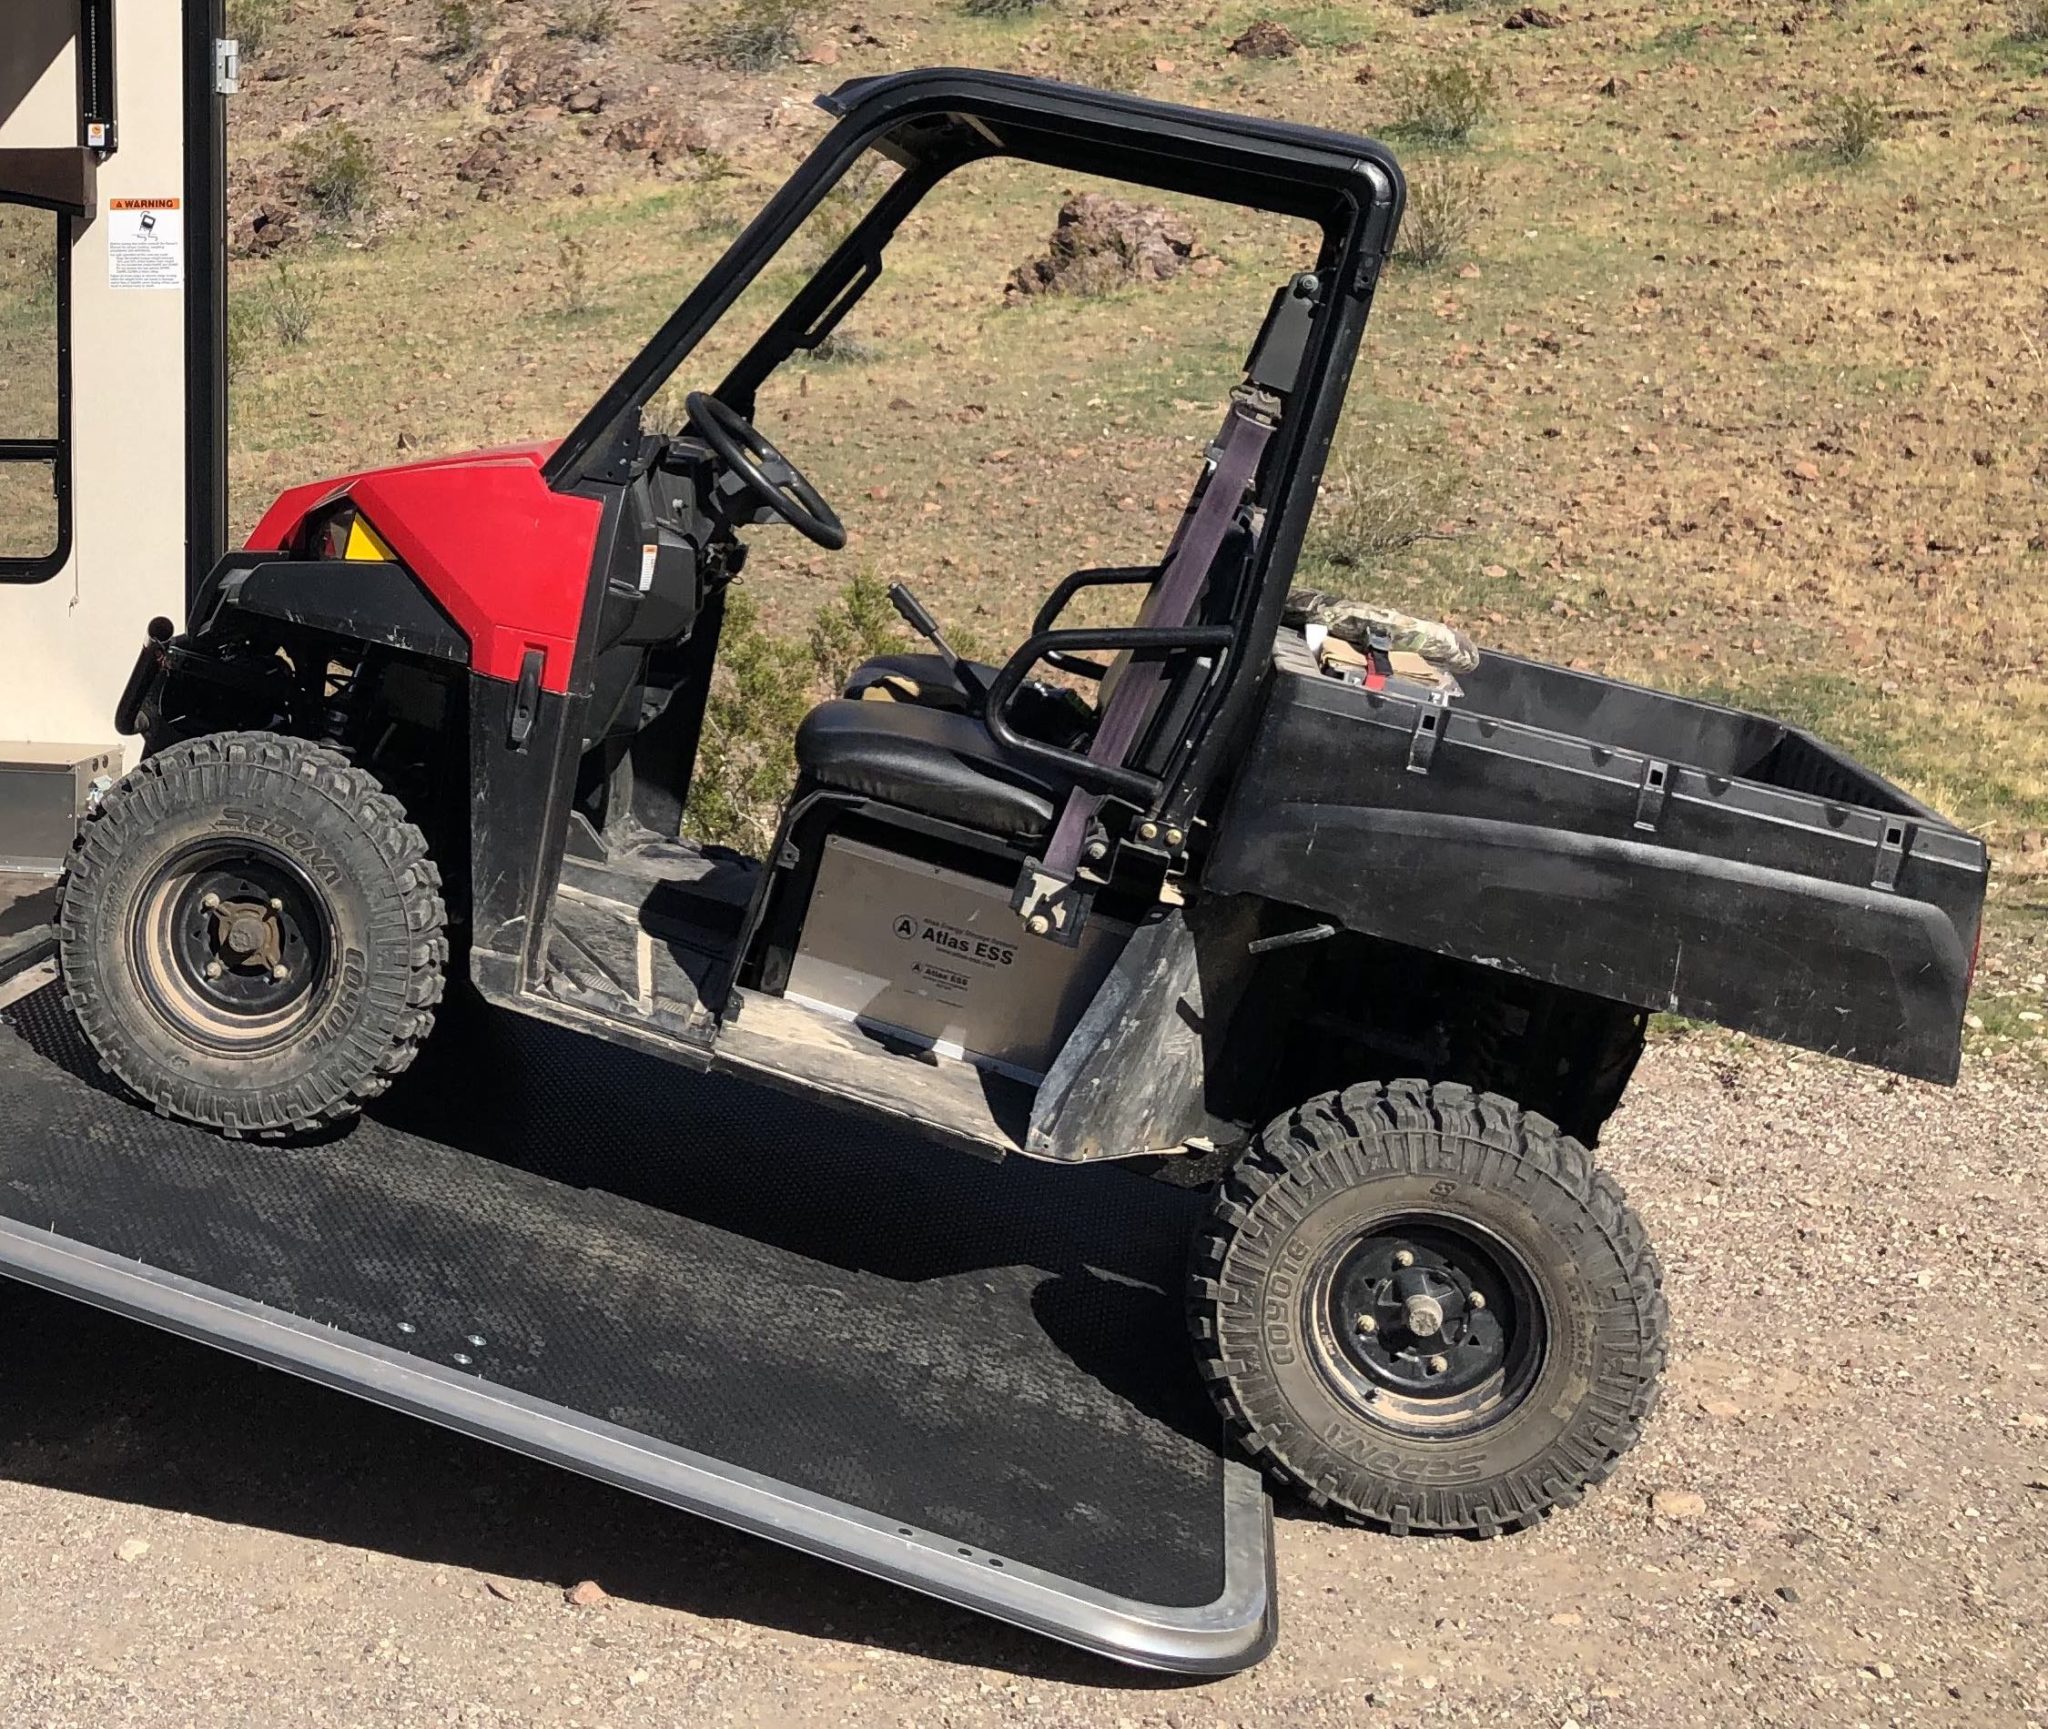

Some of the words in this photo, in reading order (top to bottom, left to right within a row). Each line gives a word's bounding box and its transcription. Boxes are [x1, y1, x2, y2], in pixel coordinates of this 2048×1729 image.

[124, 200, 173, 208] WARNING
[216, 806, 343, 887] SEDONA
[922, 927, 969, 952] Atlas
[975, 942, 1014, 965] ESS
[309, 948, 365, 1060] COYOTE
[1263, 1238, 1309, 1365] COYOTE
[1324, 1422, 1487, 1483] SEDONA
